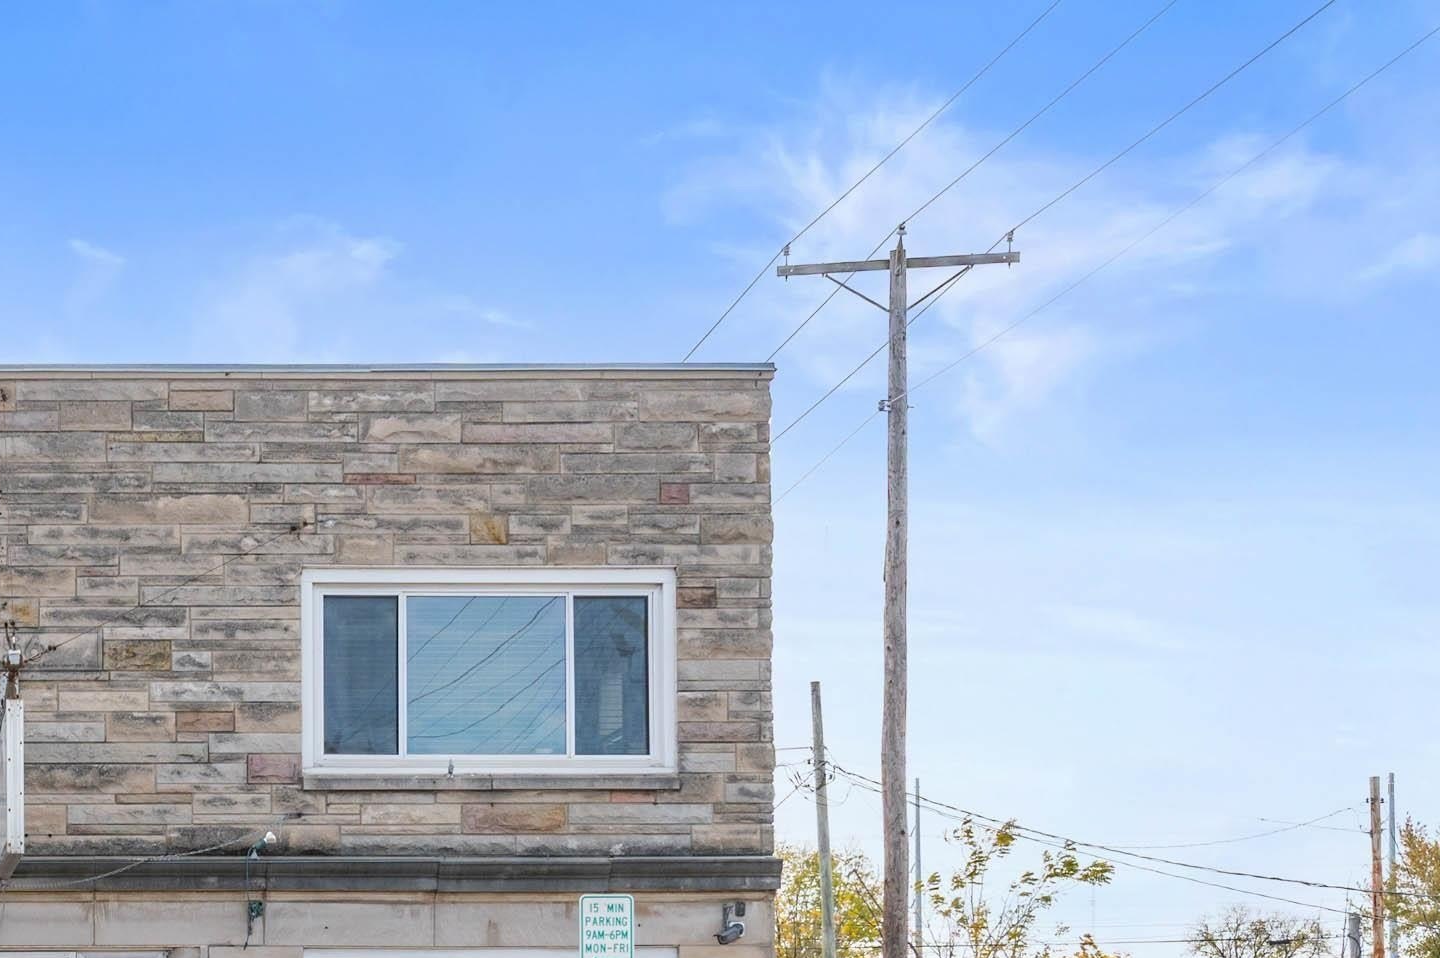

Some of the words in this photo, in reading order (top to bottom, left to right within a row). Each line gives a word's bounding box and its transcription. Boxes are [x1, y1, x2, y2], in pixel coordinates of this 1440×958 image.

[589, 903, 599, 912] 15
[607, 903, 624, 912] MIN
[585, 917, 628, 926] PARKING
[586, 930, 628, 939] 9AM-6PM
[585, 944, 629, 953] MON-FRI
